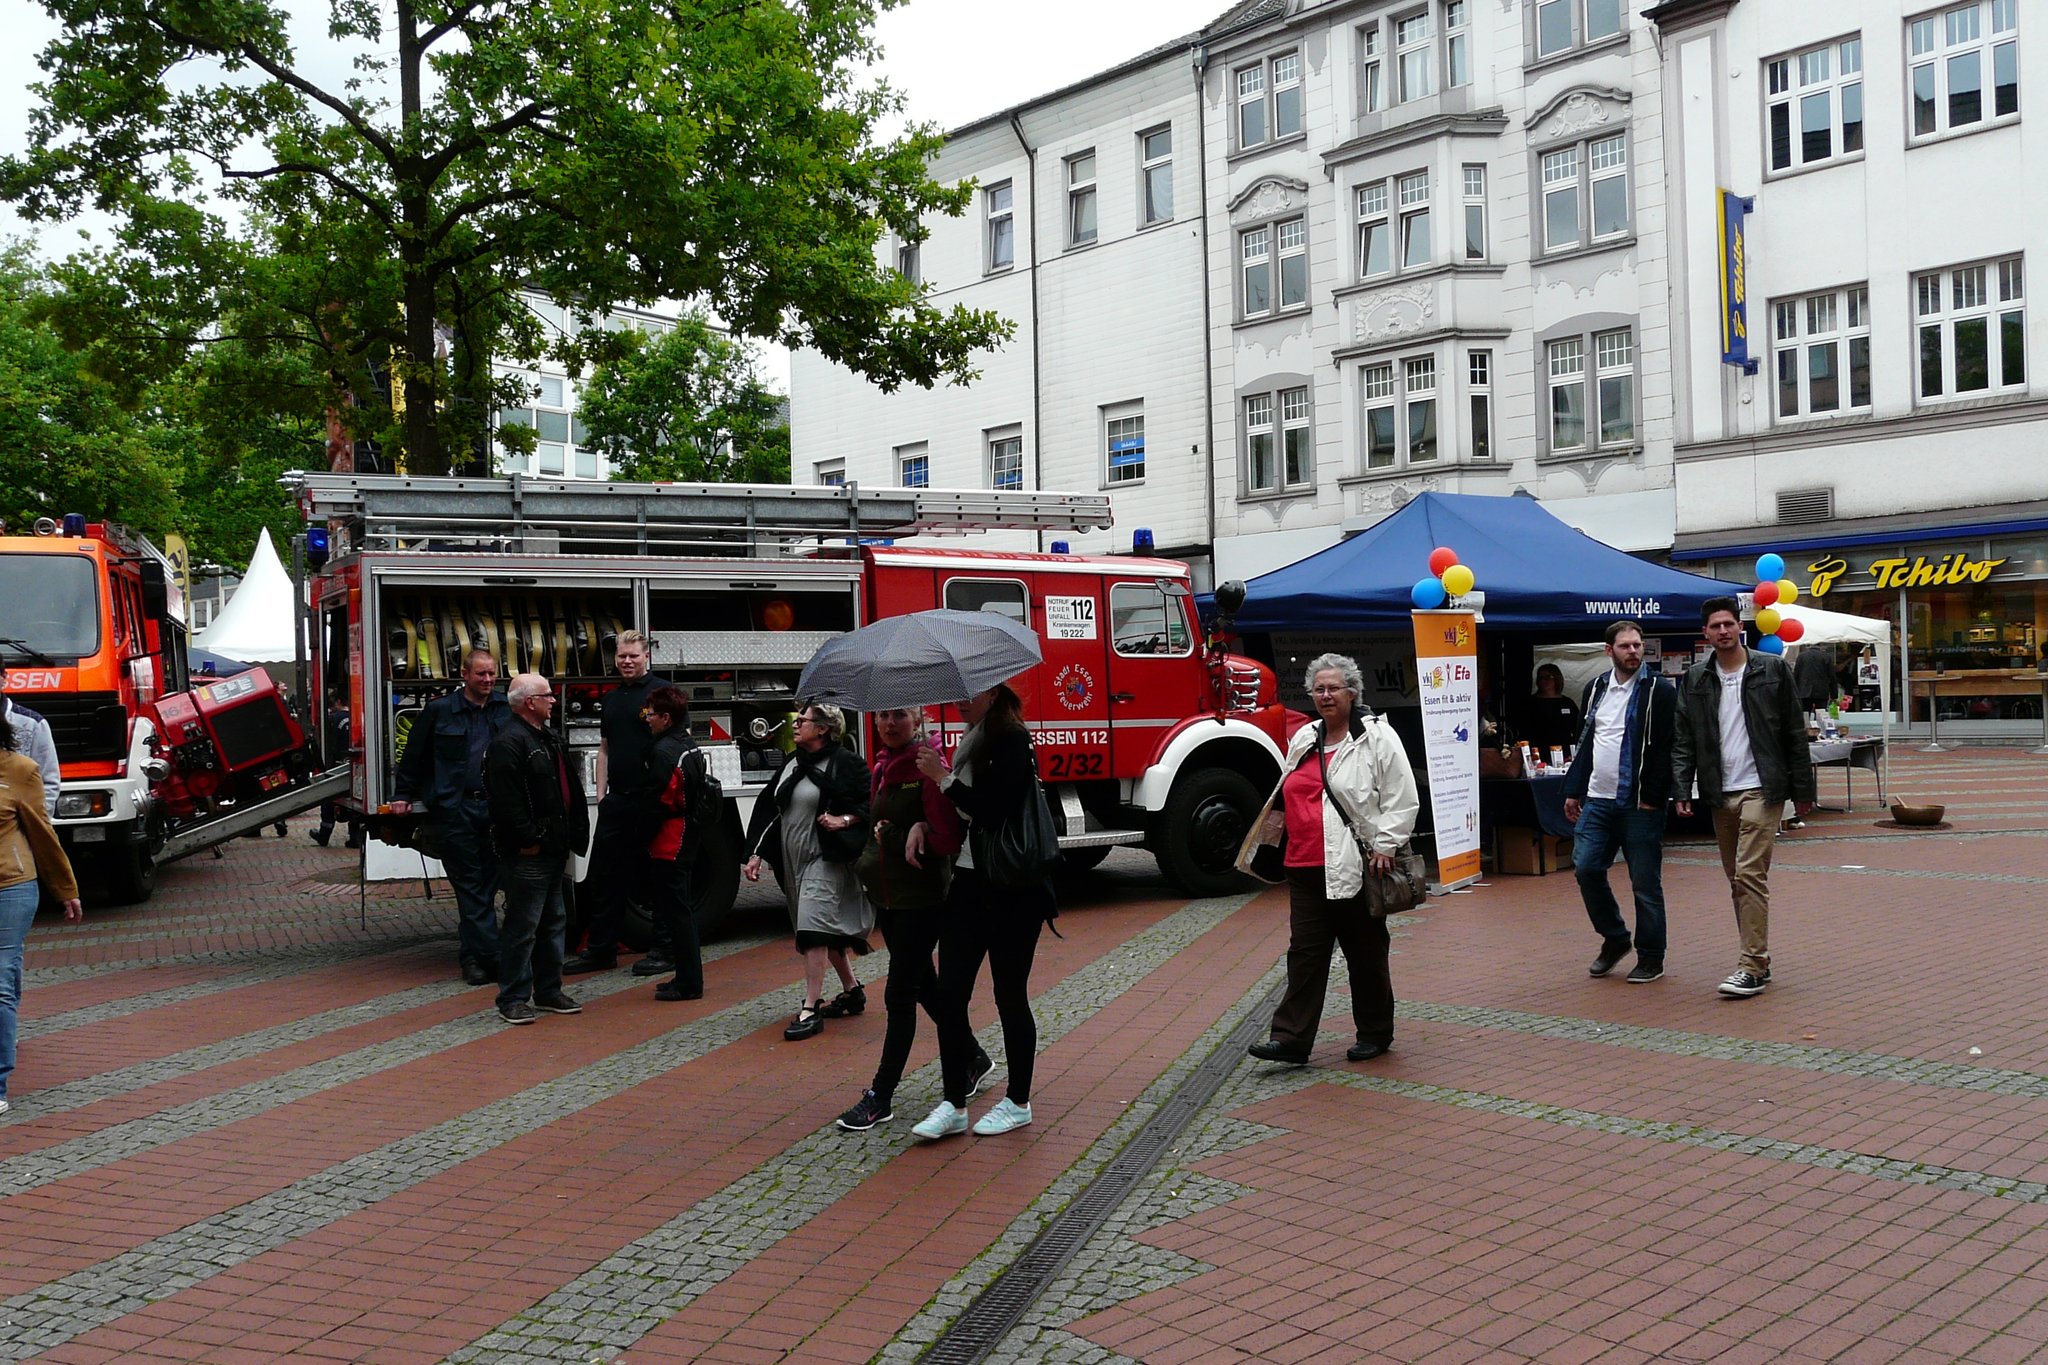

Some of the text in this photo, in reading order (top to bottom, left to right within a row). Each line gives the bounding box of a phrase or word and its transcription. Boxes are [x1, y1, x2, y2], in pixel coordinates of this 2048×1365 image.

[1733, 223, 1744, 304] Tchibo
[1868, 553, 2008, 589] Tchibo
[1071, 599, 1093, 620] 112
[1585, 598, 1660, 618] www.vkj.de
[1053, 622, 1090, 630] Krankenwagen
[1054, 664, 1093, 687] Stadt Essen
[1455, 665, 1471, 680] Efa
[1057, 691, 1093, 711] Feuerwehr
[1424, 696, 1440, 705] Essen
[1081, 731, 1107, 745] 112
[1050, 753, 1103, 777] 2/32
